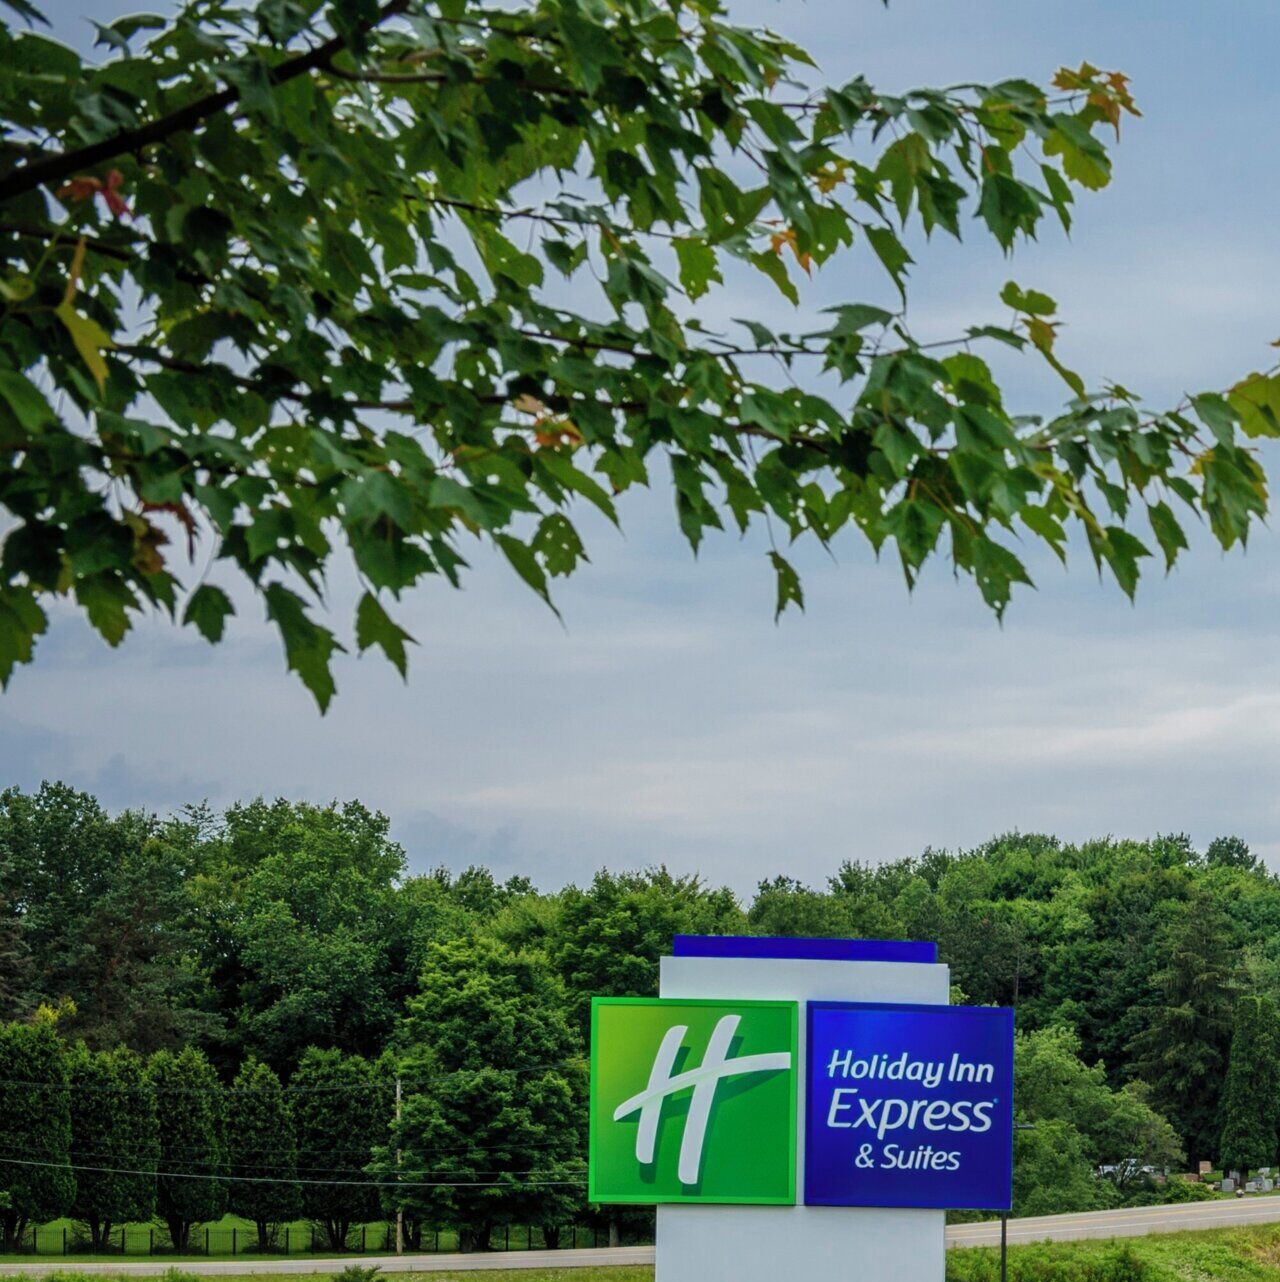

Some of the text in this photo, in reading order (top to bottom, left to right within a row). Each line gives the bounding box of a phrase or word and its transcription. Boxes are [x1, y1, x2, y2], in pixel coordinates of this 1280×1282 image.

[826, 1049, 995, 1089] Holiday Inn
[827, 1088, 994, 1140] Express
[855, 1144, 961, 1171] & Suites
